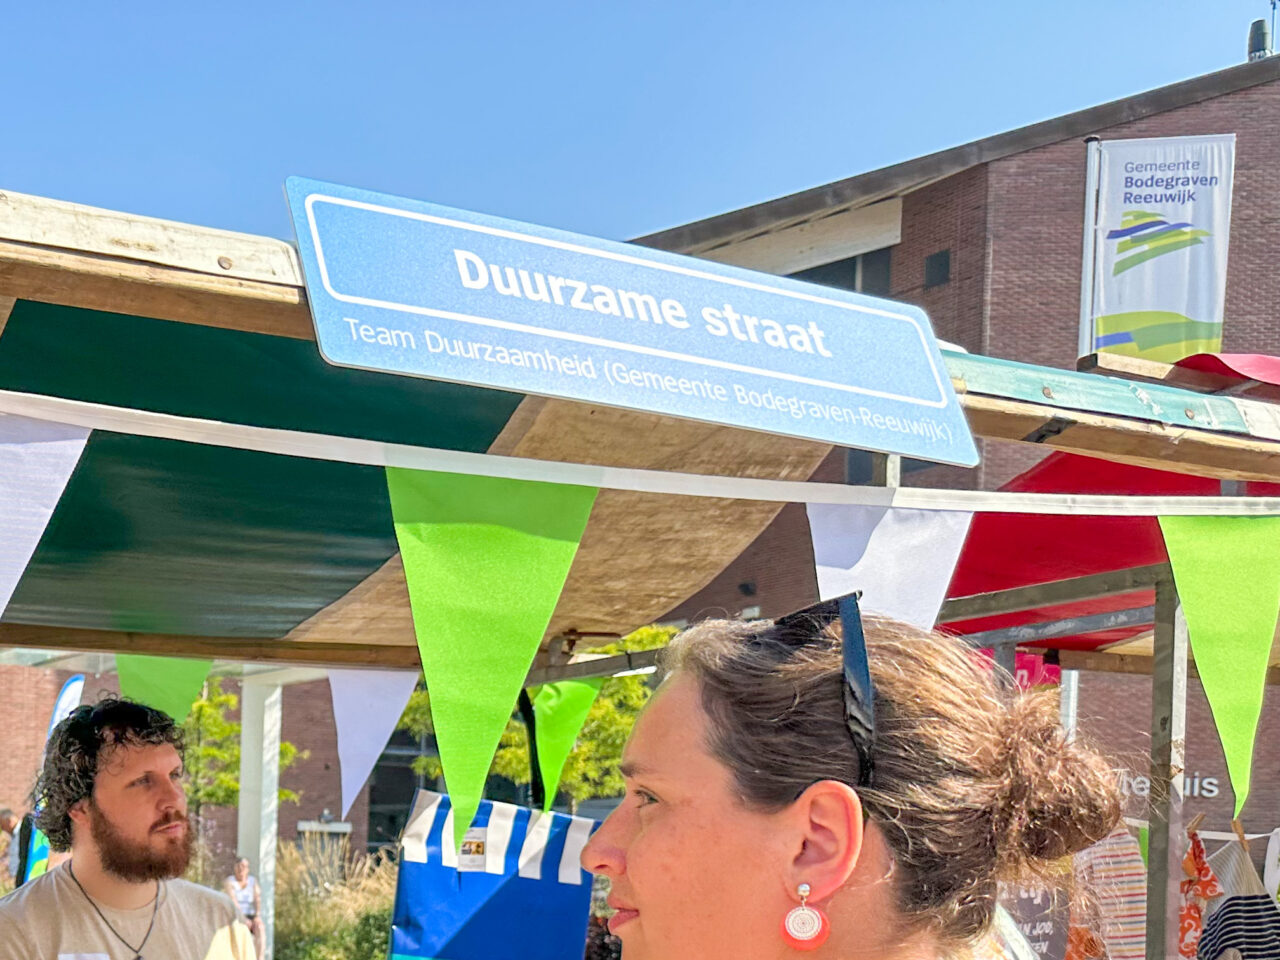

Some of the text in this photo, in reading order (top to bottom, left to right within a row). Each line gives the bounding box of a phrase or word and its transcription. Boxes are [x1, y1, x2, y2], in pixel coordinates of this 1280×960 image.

[1124, 160, 1201, 173] Gemeente
[1124, 174, 1218, 190] Bodegraven
[1123, 189, 1197, 205] Reeuwijk
[453, 248, 834, 358] Duurzame straat
[343, 317, 954, 446] Team Duurzaamheid (Gemeente Bodegraven-Reeuwijk)
